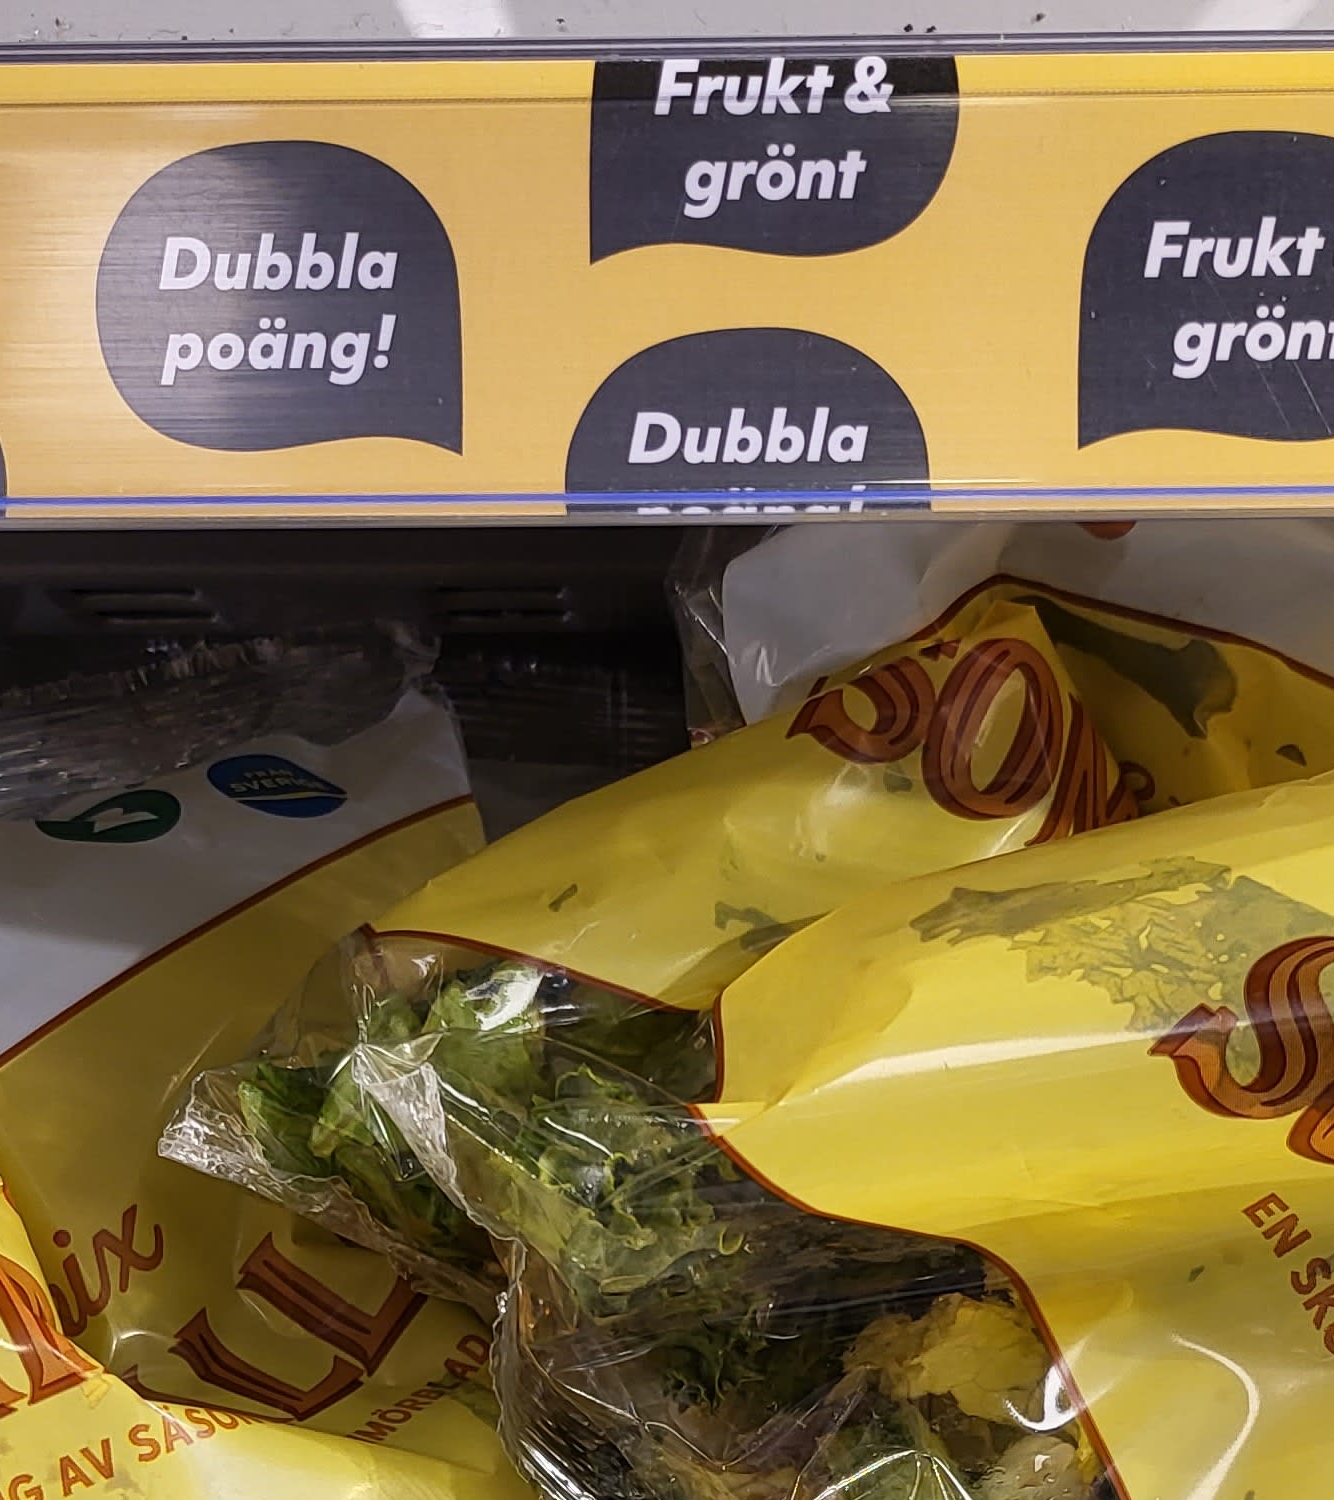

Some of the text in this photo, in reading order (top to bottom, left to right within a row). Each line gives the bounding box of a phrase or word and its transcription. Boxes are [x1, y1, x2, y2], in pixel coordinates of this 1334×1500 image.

[654, 56, 894, 116] Frukt &
[682, 145, 867, 218] grönt
[159, 232, 398, 291] Dubbla
[1144, 217, 1324, 279] Frukt
[160, 314, 396, 386] poäng!
[628, 406, 868, 465] Dubbla
[1242, 1192, 1311, 1257] EN
[59, 1438, 115, 1497] AV
